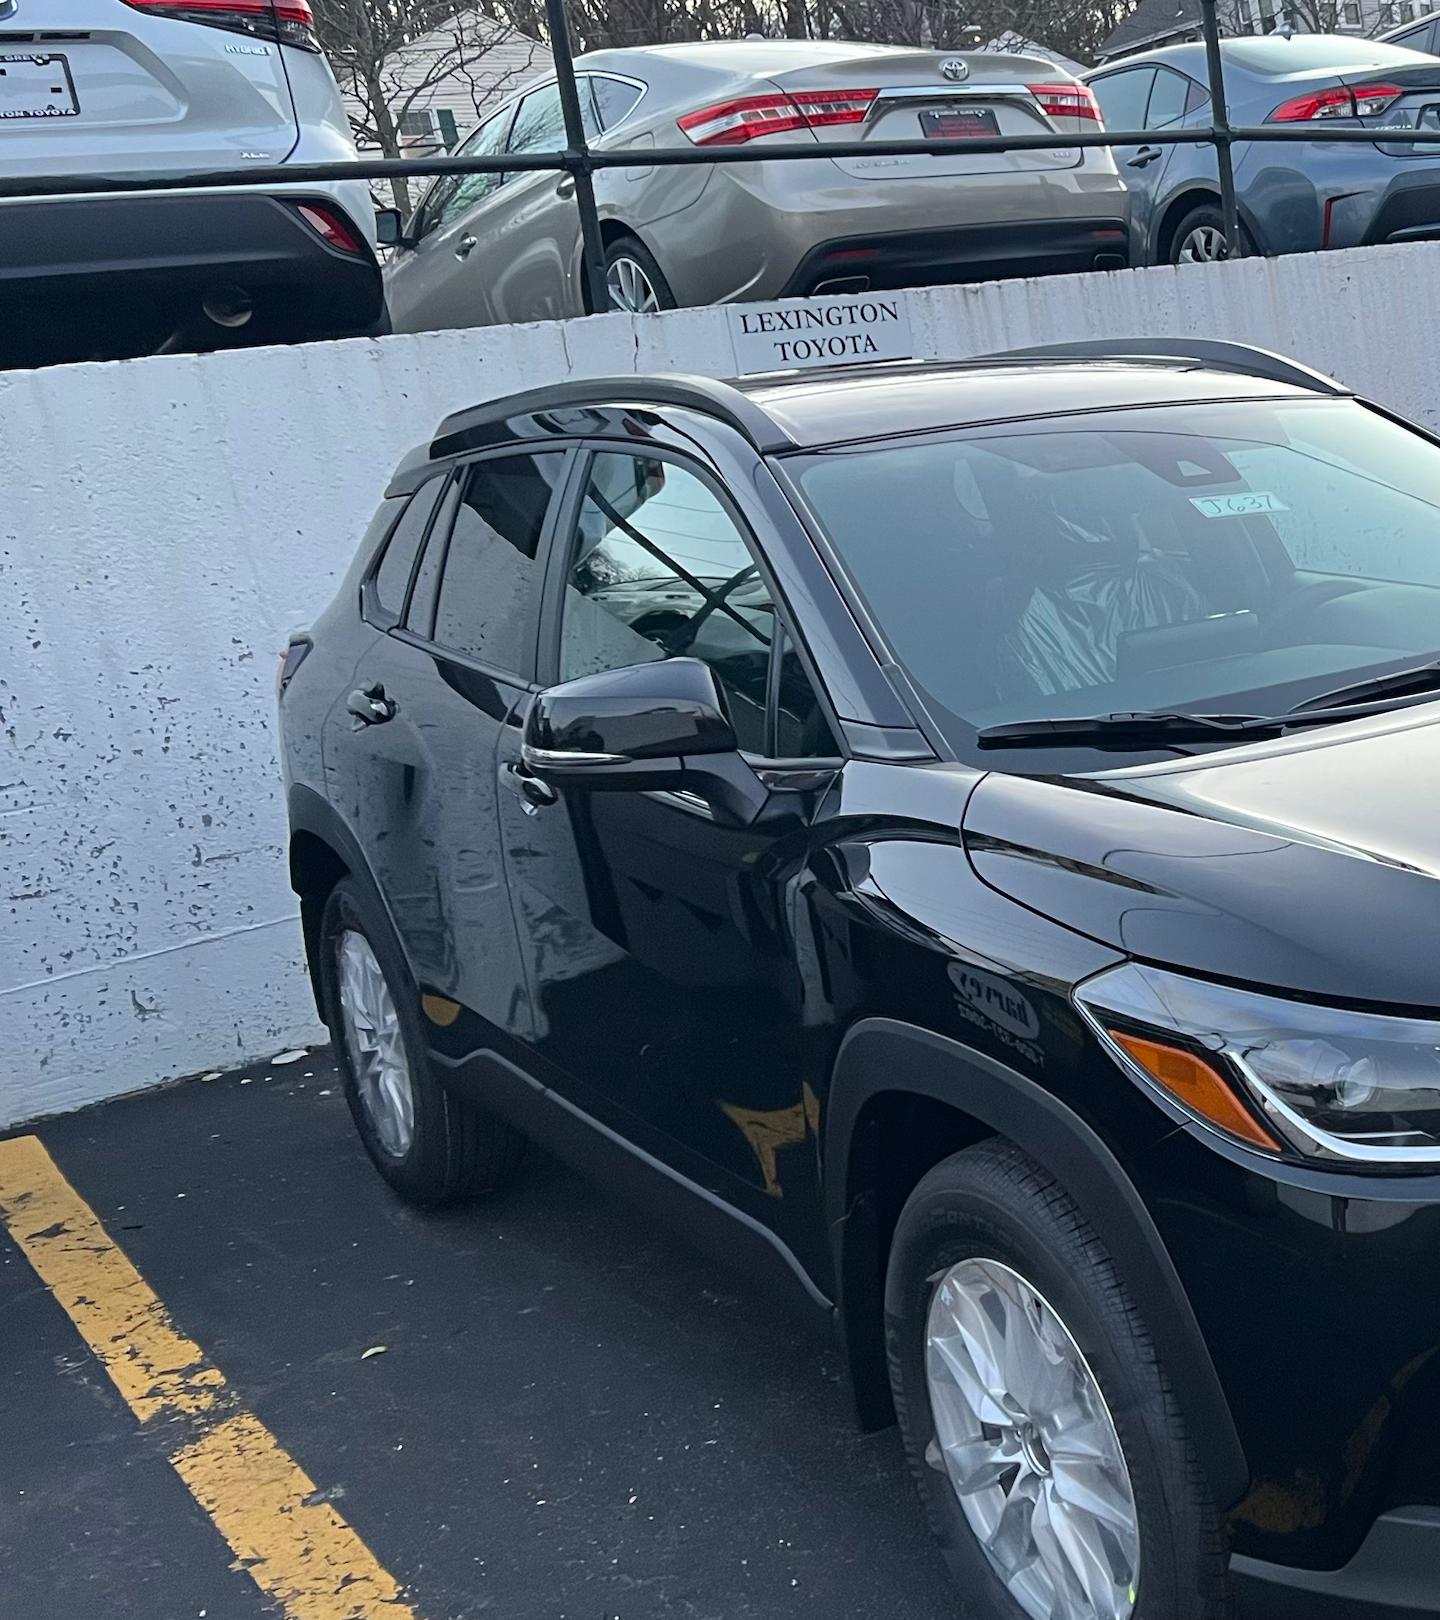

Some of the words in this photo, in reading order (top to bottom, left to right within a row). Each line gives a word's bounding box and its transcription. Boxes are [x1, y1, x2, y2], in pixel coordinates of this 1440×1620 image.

[28, 108, 76, 117] TOYOTA
[739, 302, 899, 334] LEXINGTON
[773, 334, 879, 362] TOYOTA
